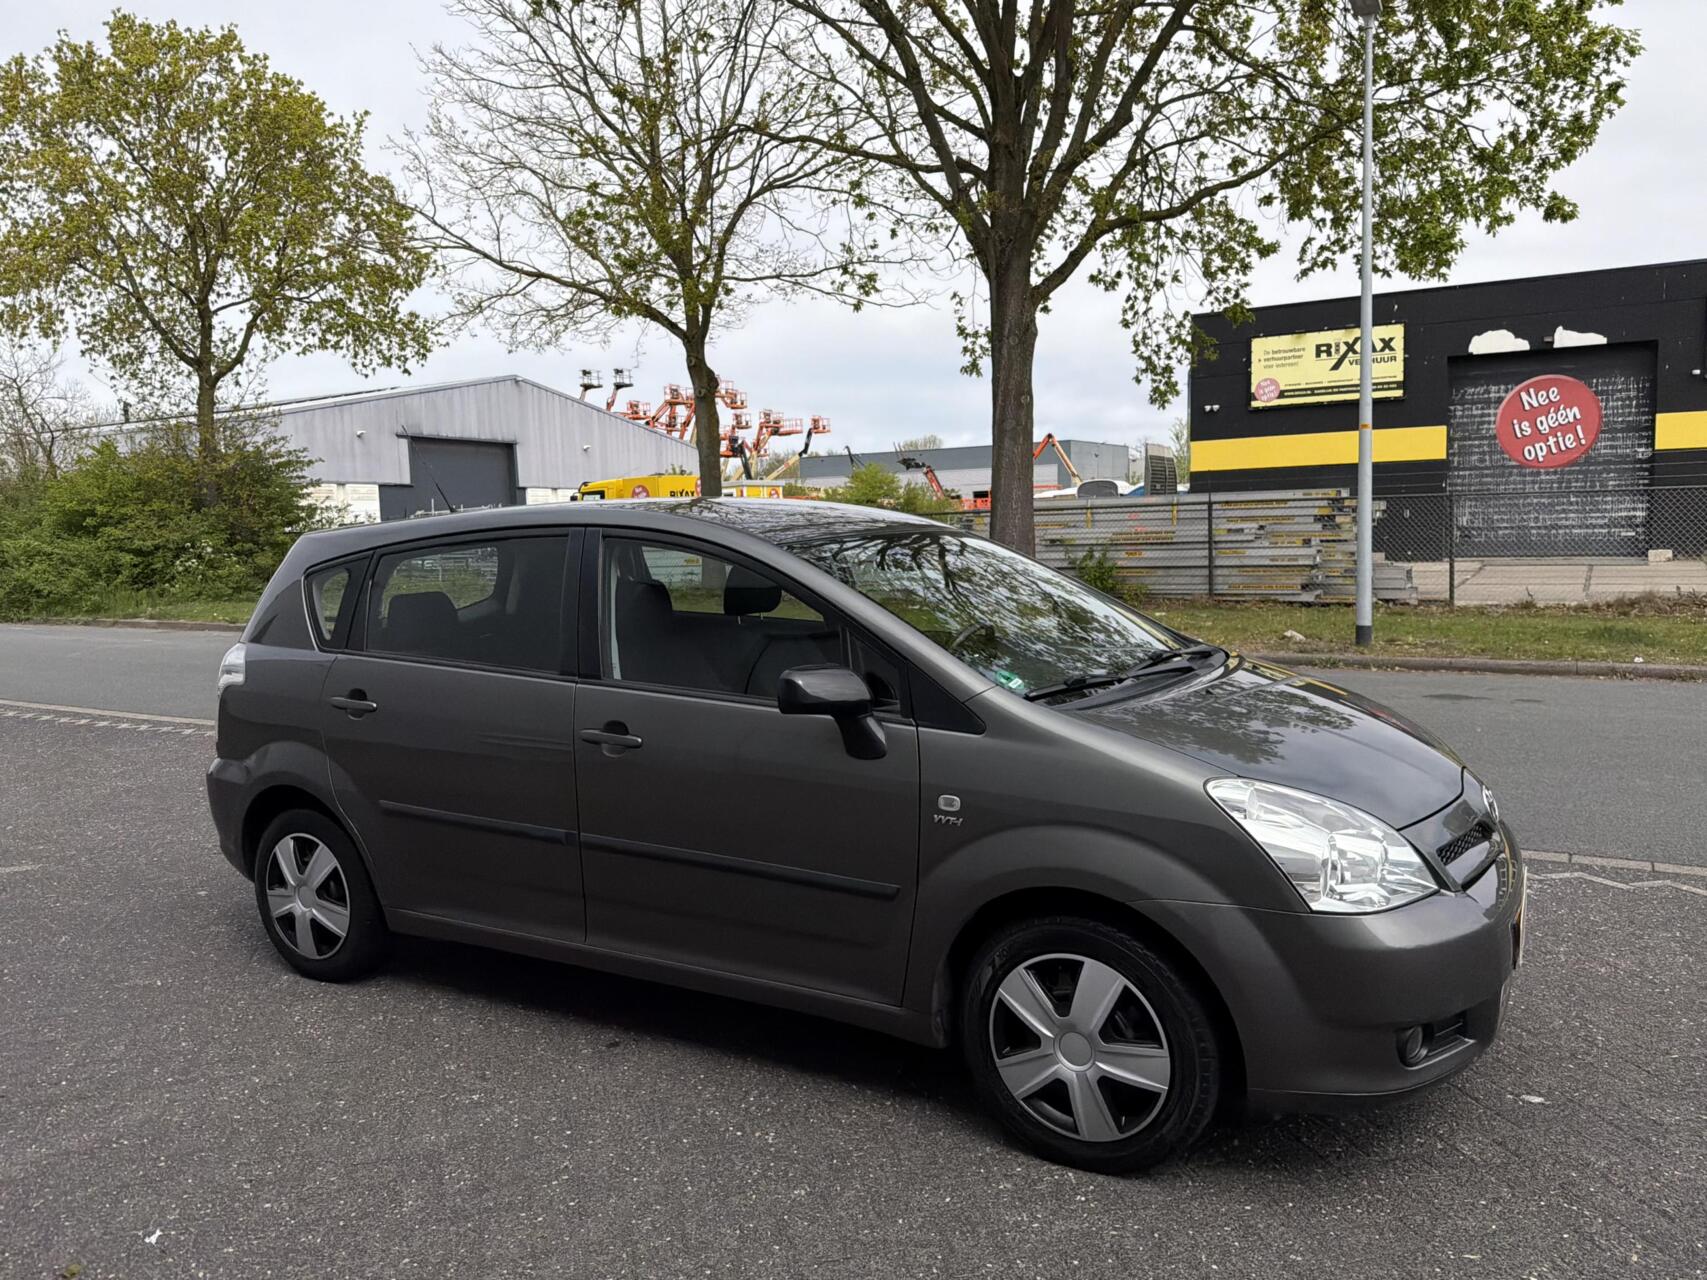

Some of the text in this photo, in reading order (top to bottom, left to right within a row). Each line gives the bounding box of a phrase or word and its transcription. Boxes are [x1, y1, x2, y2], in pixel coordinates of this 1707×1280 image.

[1348, 355, 1397, 366] VEUUR
[1520, 387, 1560, 411] Nee
[1512, 404, 1581, 438] is géén
[1523, 424, 1586, 462] optie!
